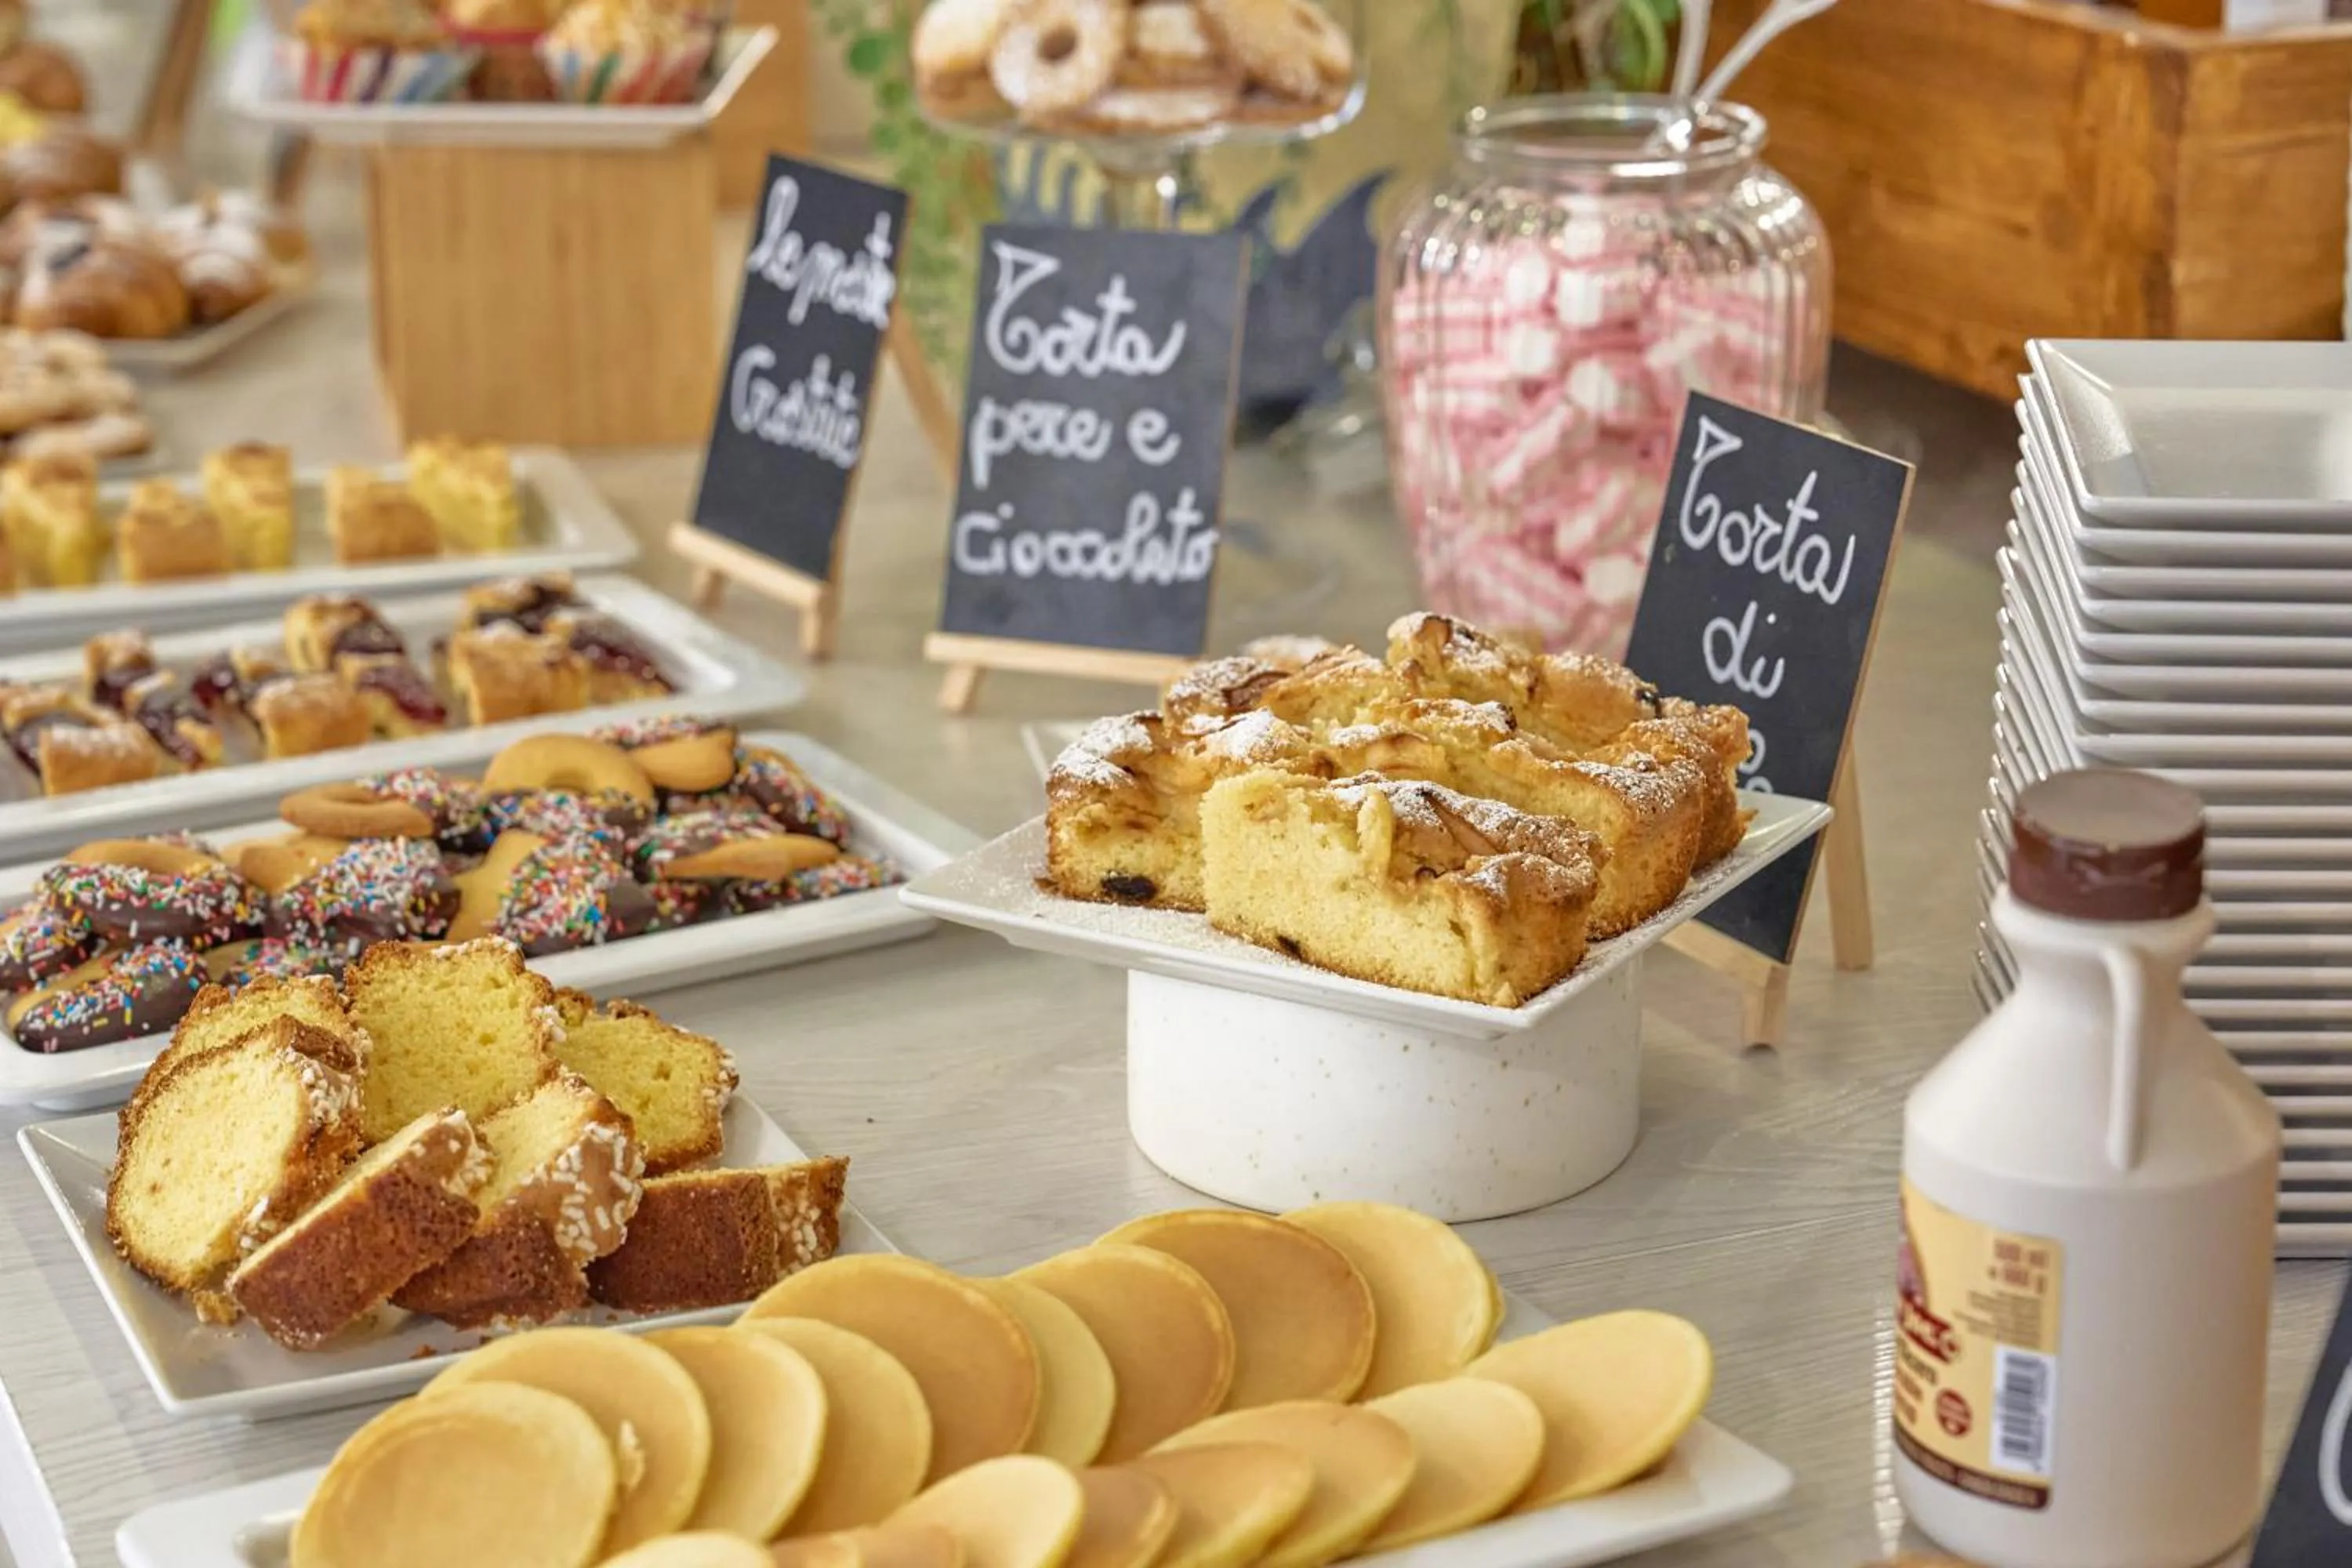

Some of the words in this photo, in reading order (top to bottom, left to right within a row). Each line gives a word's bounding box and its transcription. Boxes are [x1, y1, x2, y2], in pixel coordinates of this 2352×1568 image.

[985, 239, 1188, 377] Torta
[971, 396, 1112, 488] pere
[1127, 408, 1180, 465] e
[953, 486, 1219, 584] Cioccolato
[1681, 415, 1857, 604] Torta
[1703, 601, 1784, 698] di
